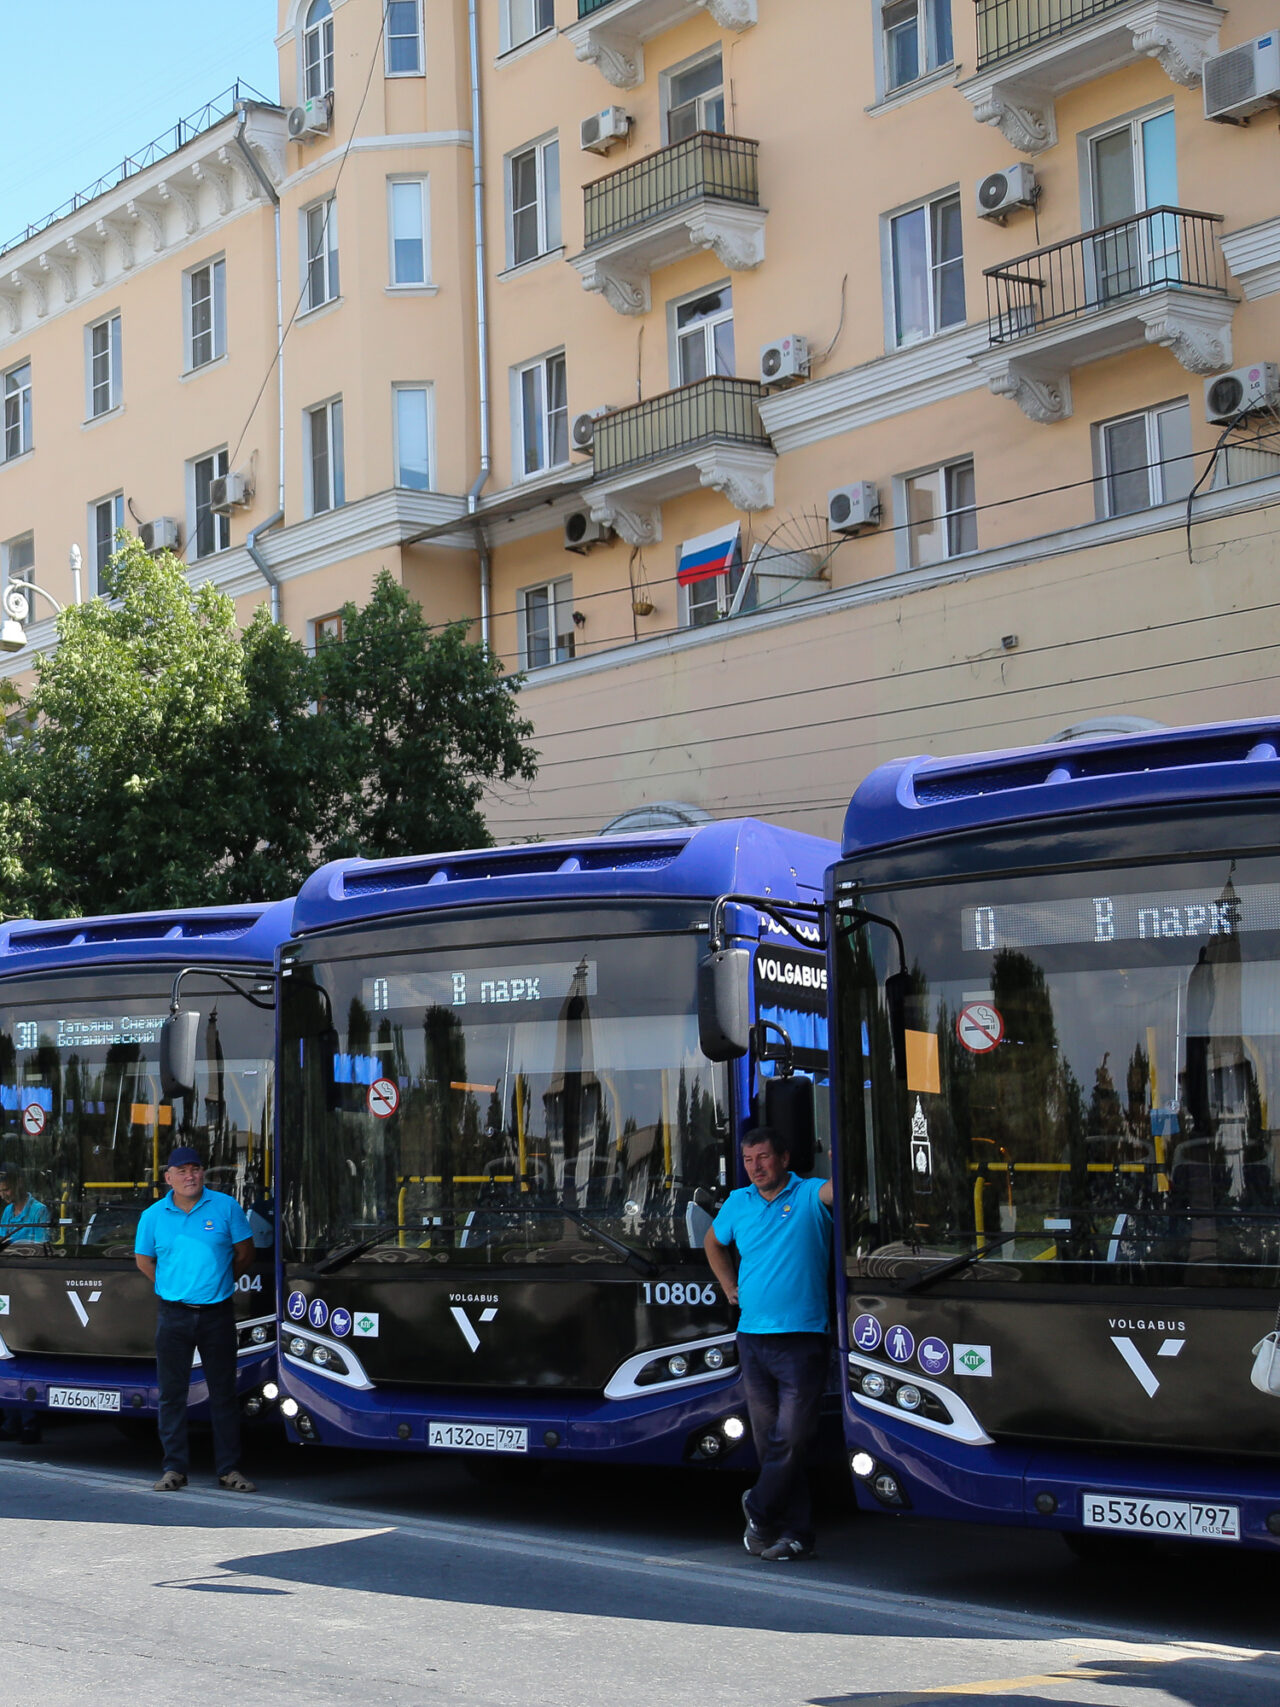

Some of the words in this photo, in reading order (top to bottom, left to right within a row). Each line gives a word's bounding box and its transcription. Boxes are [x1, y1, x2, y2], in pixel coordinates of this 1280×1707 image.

[1250, 381, 1261, 390] LG
[757, 957, 827, 990] VOLGABUS
[57, 1019, 114, 1033] Татьяны
[16, 1021, 38, 1050] 30
[56, 1031, 155, 1047] Ботанический
[449, 1293, 499, 1303] VOLGABUS
[642, 1282, 717, 1305] 10806
[1108, 1318, 1187, 1331] VOLGABUS
[964, 1355, 980, 1366] КПГ
[99, 1393, 117, 1405] 797
[498, 1429, 522, 1445] 797
[1192, 1506, 1231, 1528] 797
[1202, 1525, 1222, 1535] RUS
